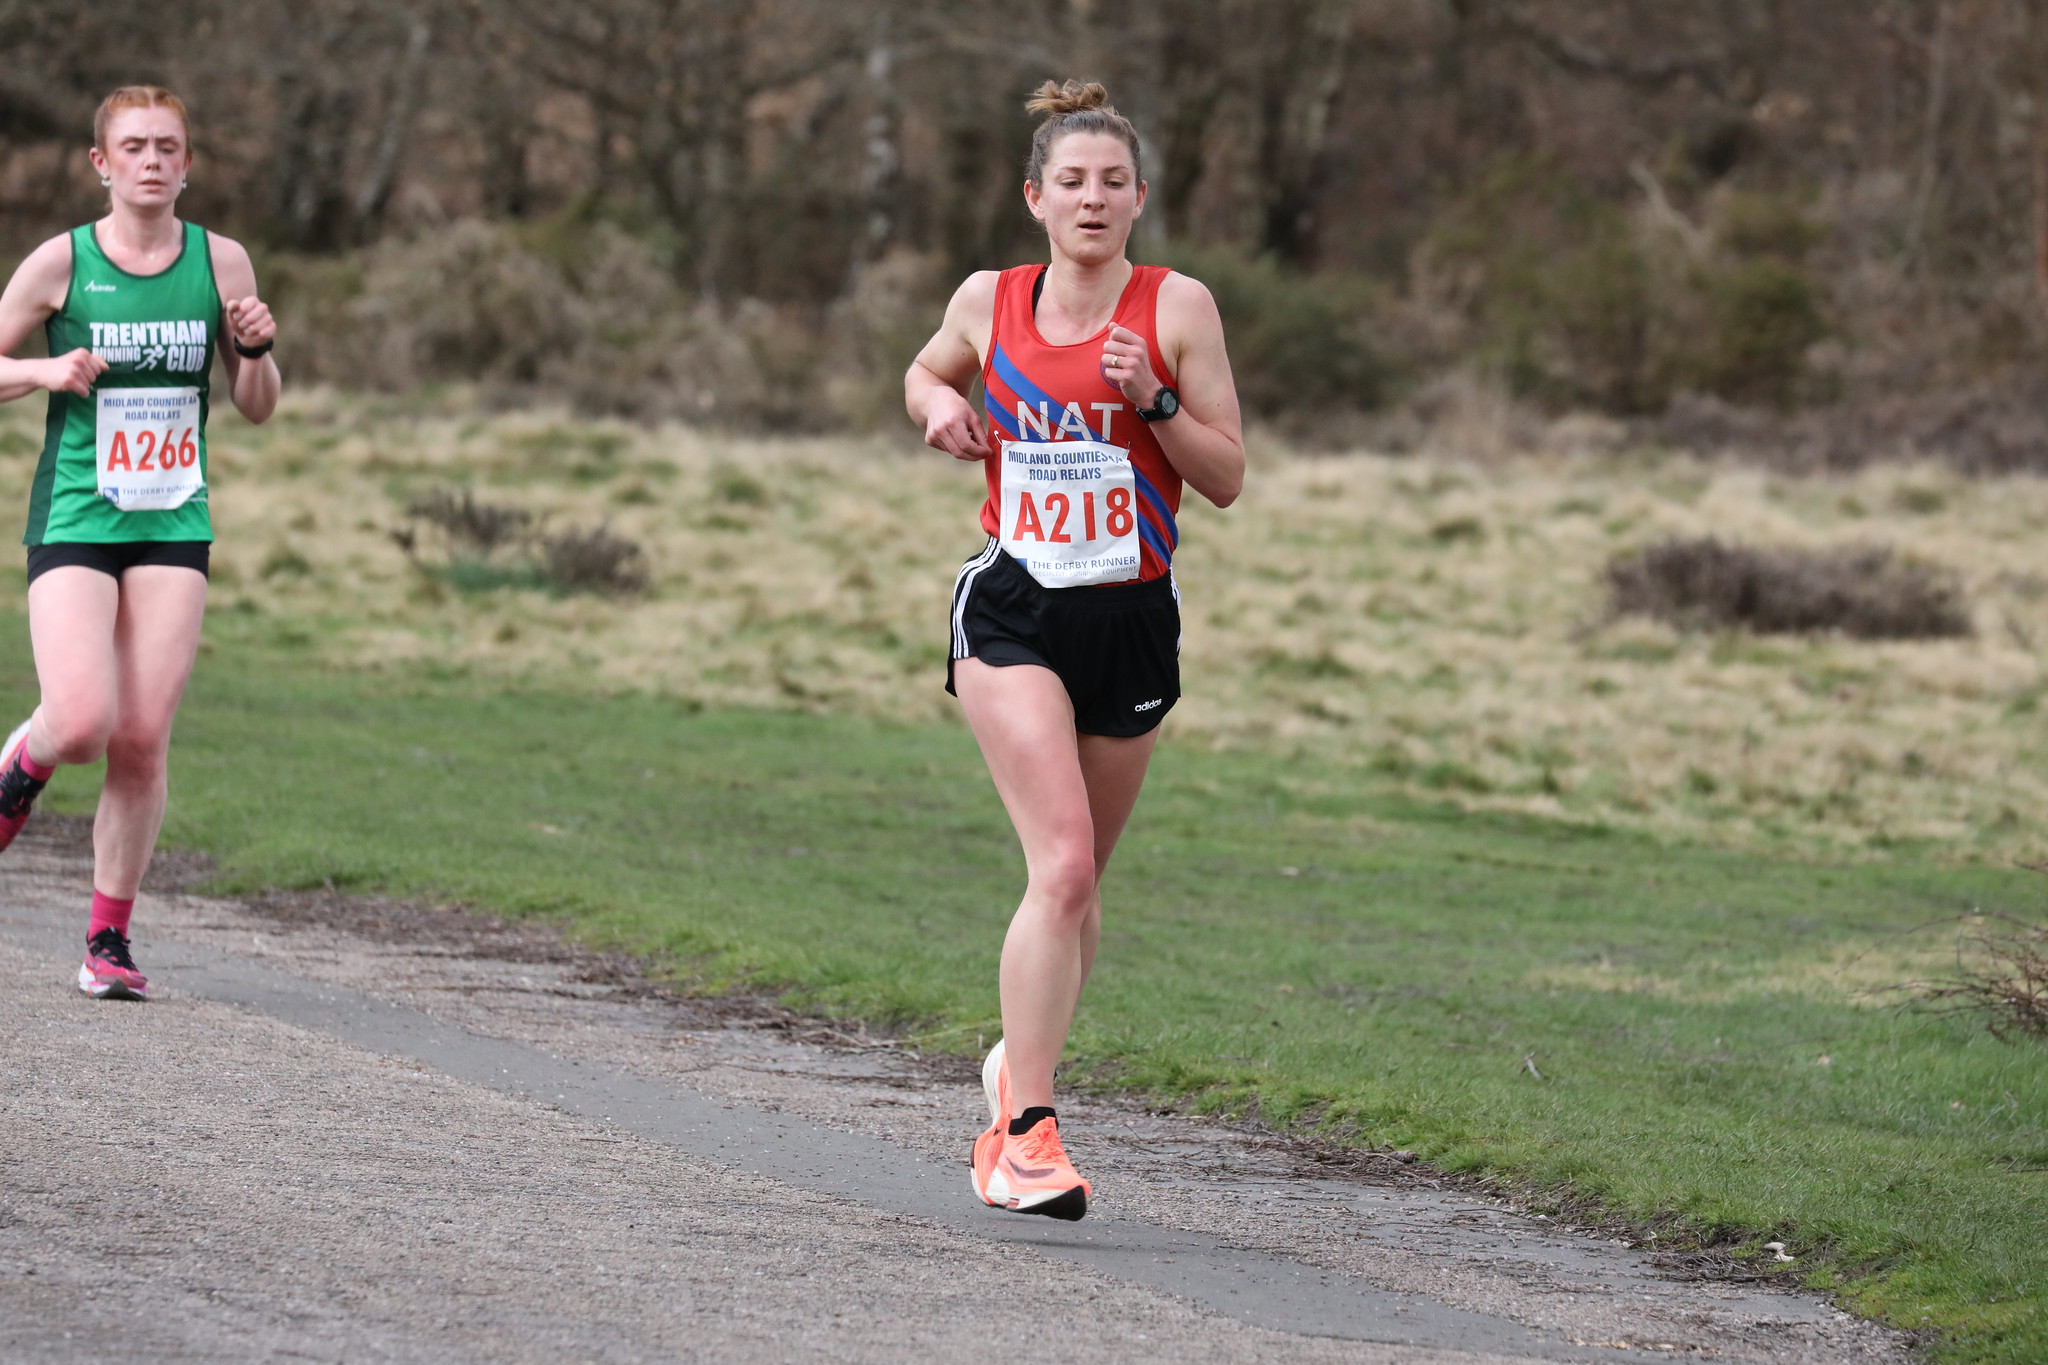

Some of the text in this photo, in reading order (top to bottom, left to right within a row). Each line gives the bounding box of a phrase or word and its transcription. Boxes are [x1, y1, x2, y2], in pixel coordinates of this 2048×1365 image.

[89, 320, 206, 346] TRENTHAM
[166, 345, 206, 372] CLUB
[103, 398, 145, 408] MIDLAND
[147, 396, 187, 407] COUNTIES
[125, 410, 181, 421] ROAD RELAYS
[1017, 400, 1124, 442] NAT
[107, 426, 196, 472] A266
[1008, 450, 1051, 465] MIDLAND
[1054, 450, 1108, 465] COUNTIES
[1029, 467, 1102, 481] ROAD RELAYS
[1012, 487, 1134, 543] A218
[1032, 556, 1136, 571] THE DERBY RUNNER
[1102, 566, 1137, 575] EQUIPMENT
[1134, 698, 1162, 712] adidas
